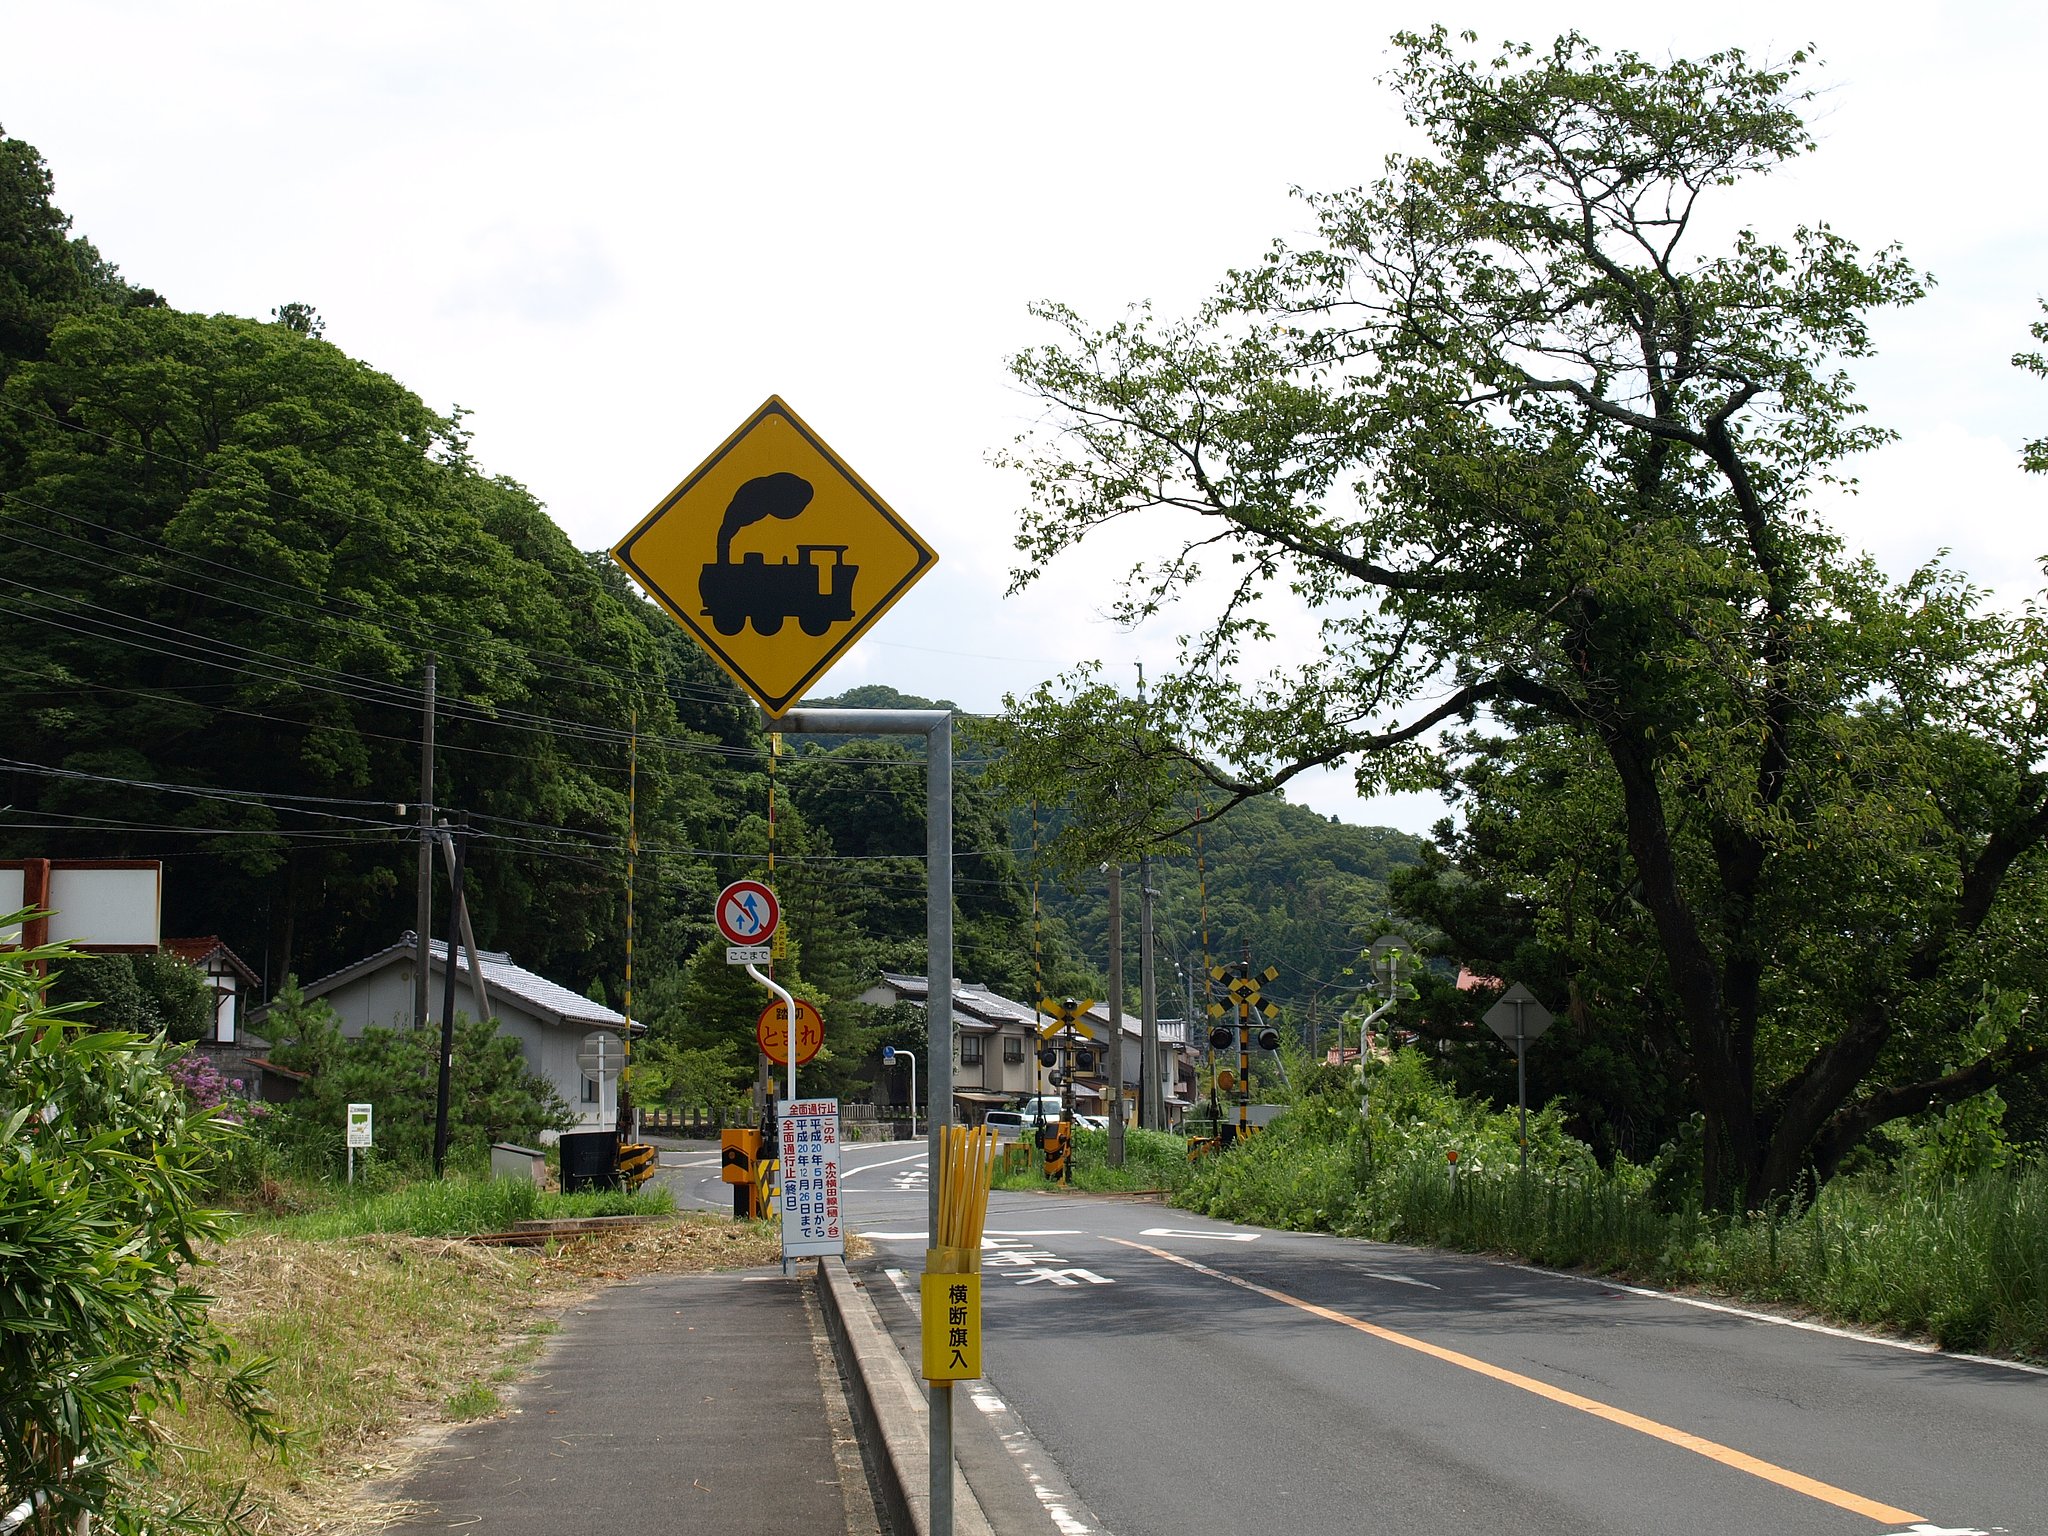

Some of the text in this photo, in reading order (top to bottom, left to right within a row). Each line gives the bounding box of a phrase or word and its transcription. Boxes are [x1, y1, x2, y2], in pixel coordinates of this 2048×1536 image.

[730, 951, 768, 960] ここまで
[789, 1102, 837, 1116] 全面通行止
[824, 1118, 835, 1144] この先
[796, 1119, 811, 1238] 平成20年12月26日まで
[810, 1118, 825, 1238] 平成20年5月8日から
[949, 1284, 968, 1369] 横断旗入
